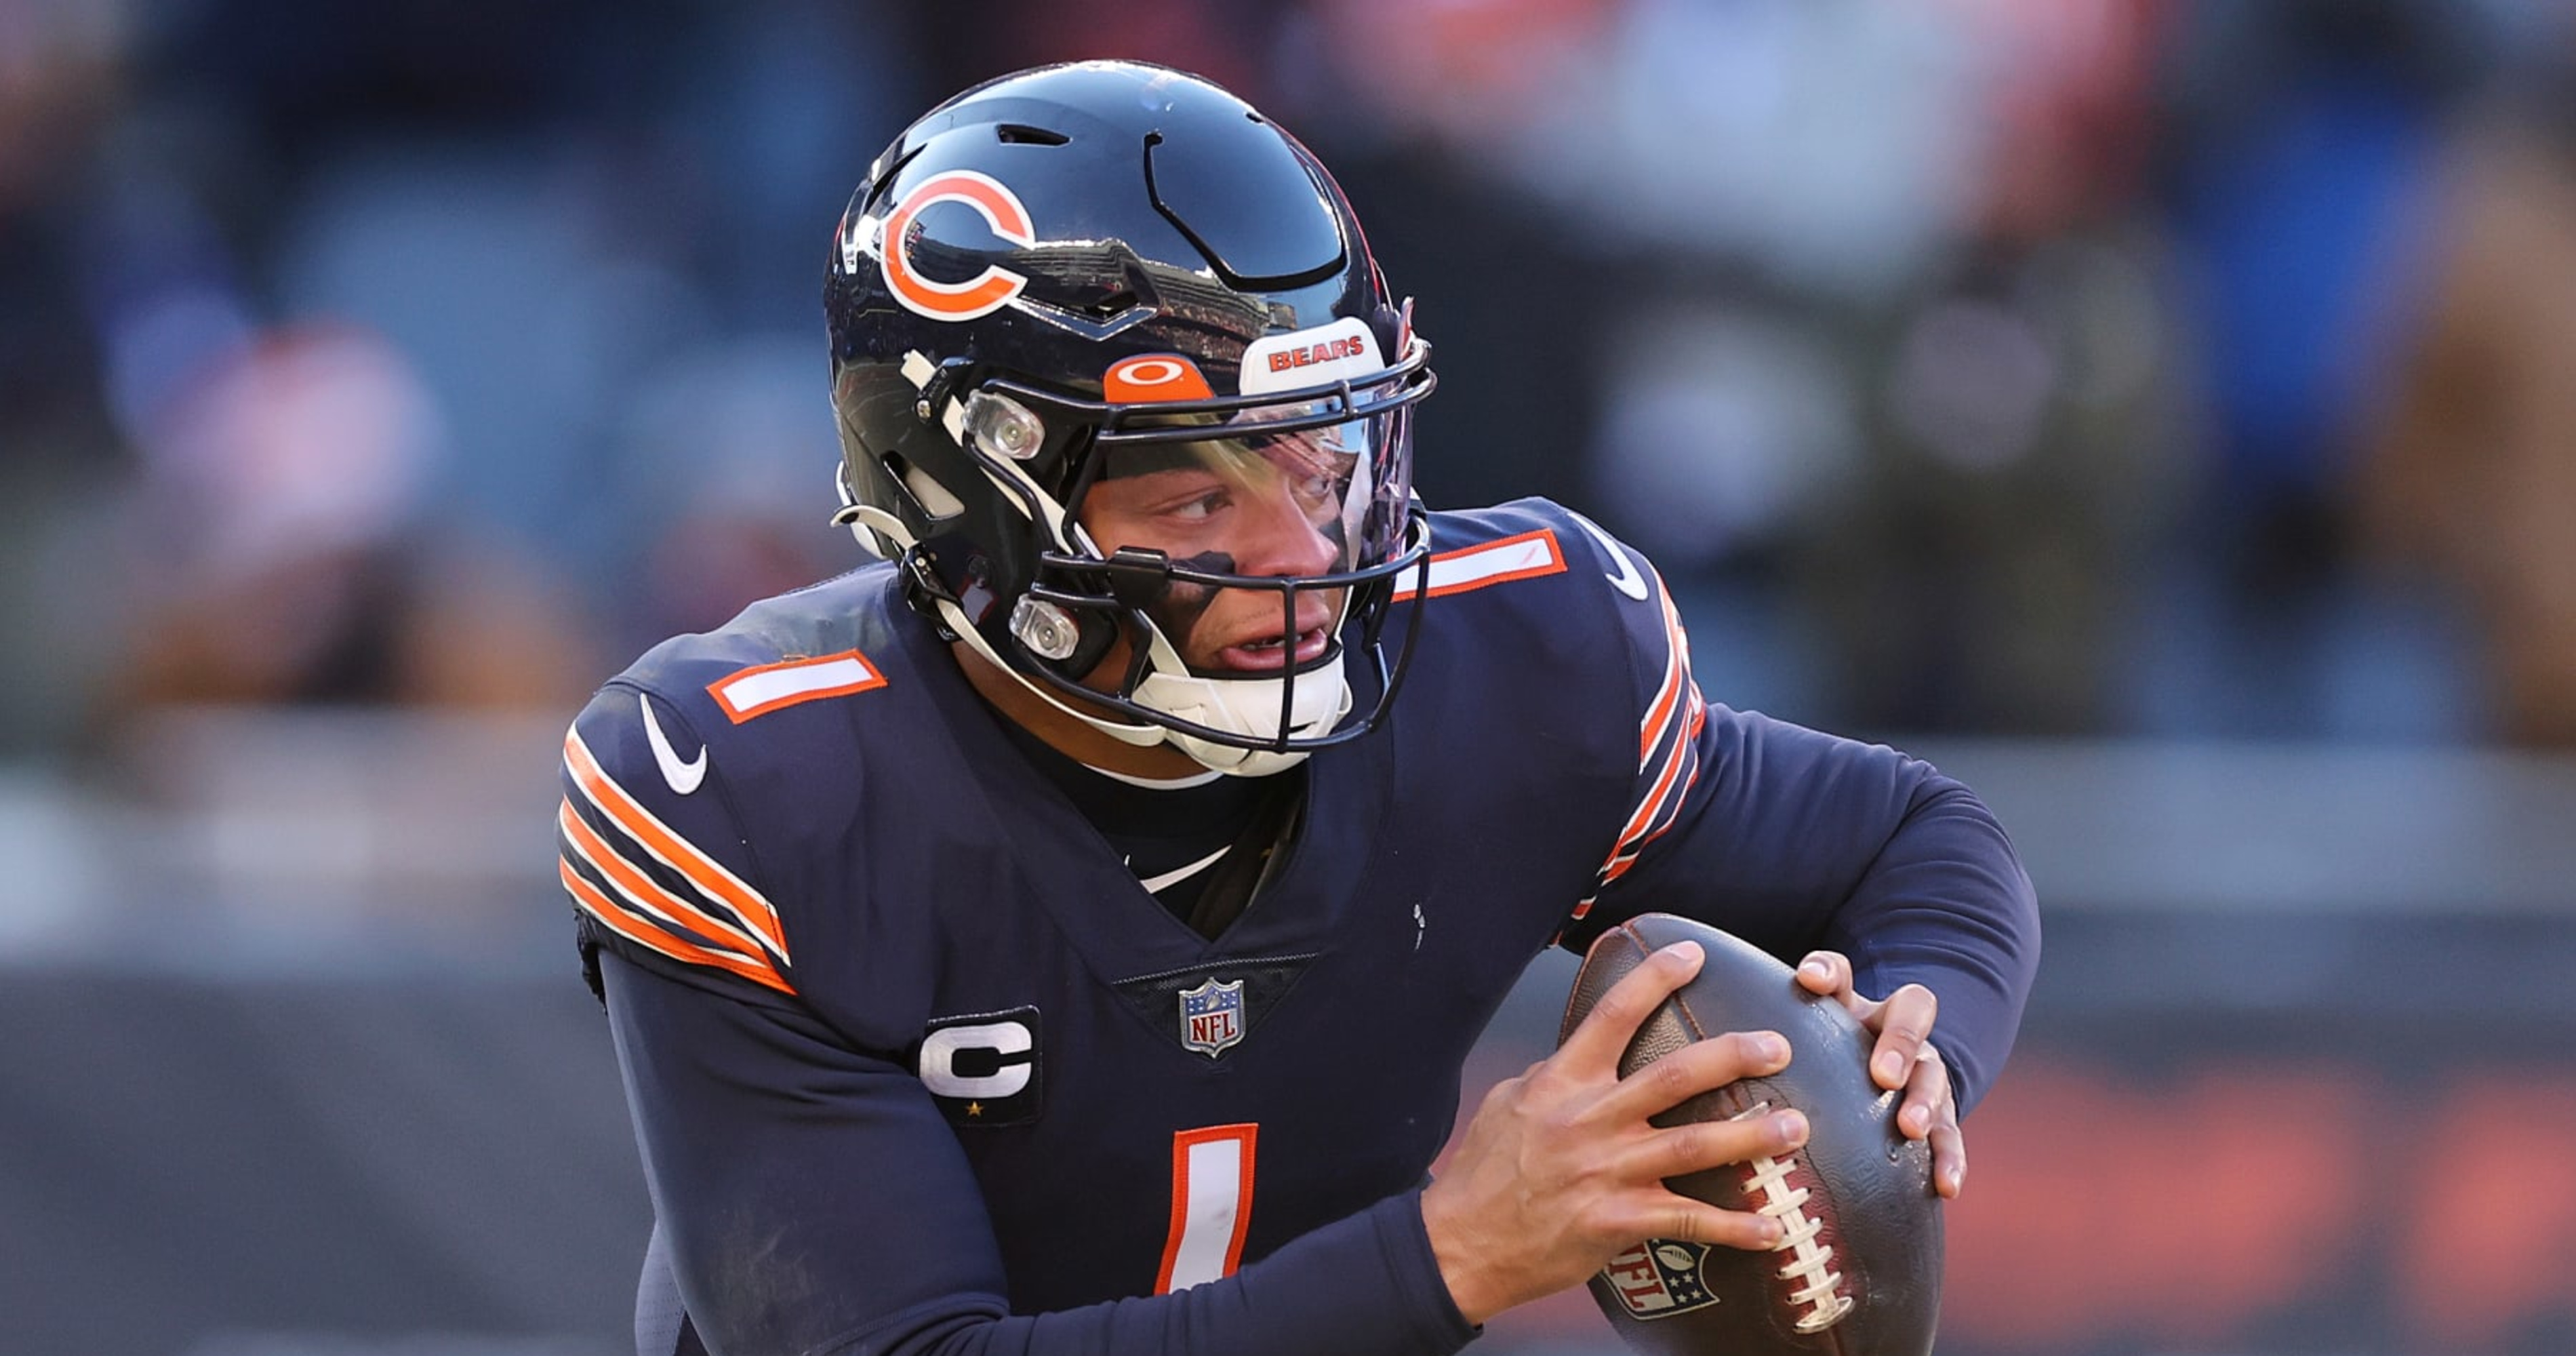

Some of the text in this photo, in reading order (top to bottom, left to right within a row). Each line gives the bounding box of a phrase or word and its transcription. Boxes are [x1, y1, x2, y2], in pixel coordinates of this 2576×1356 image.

[881, 170, 1035, 321] C
[1268, 336, 1364, 372] BEARS
[706, 649, 889, 725] 1
[919, 1021, 1032, 1098] C
[1191, 1013, 1236, 1043] NFL
[1154, 1123, 1259, 1296] 1
